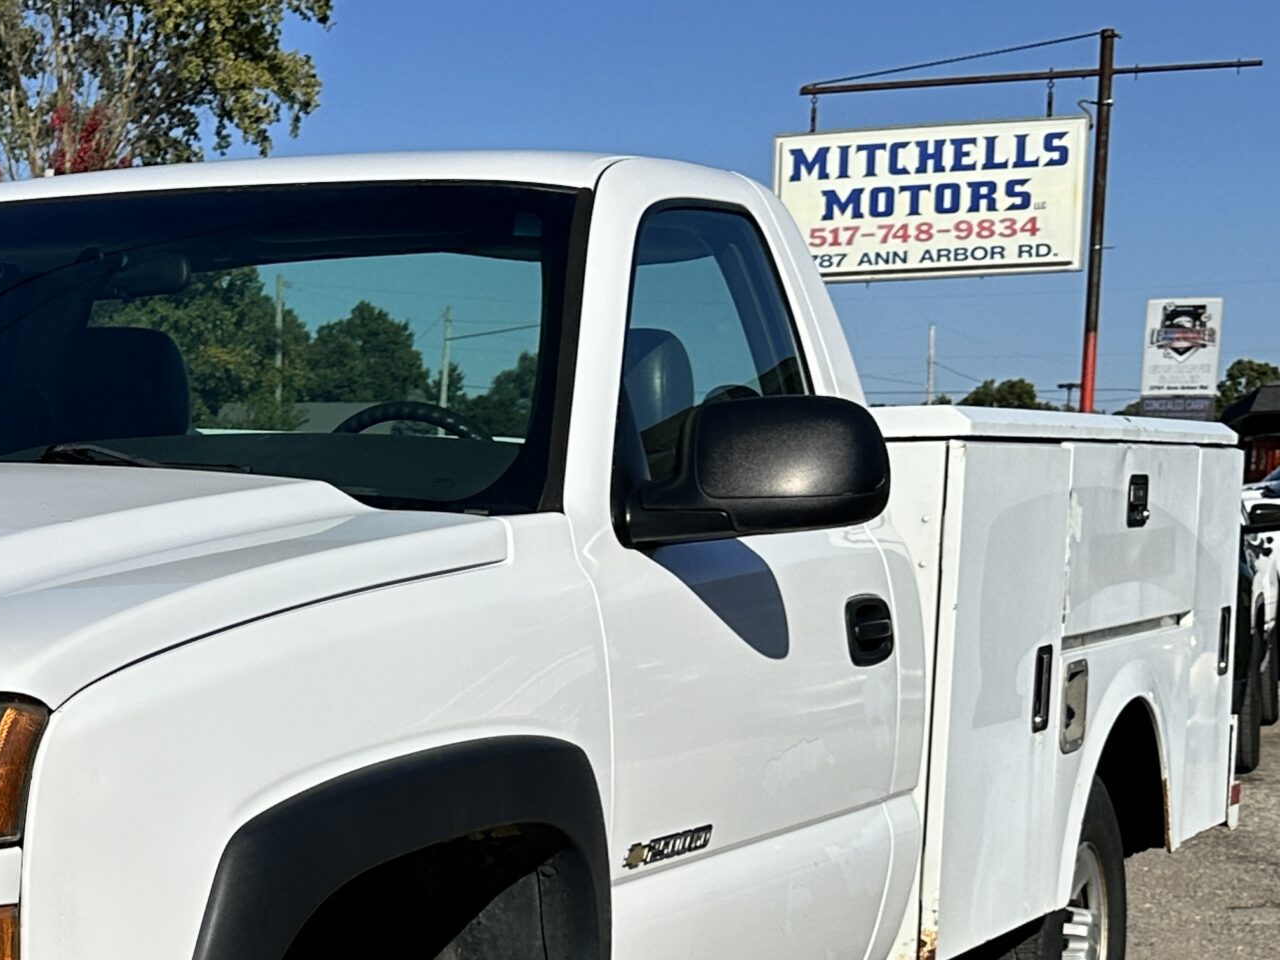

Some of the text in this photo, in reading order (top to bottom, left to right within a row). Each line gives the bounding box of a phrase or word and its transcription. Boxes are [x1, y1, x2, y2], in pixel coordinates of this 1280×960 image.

[788, 131, 1070, 182] MITCHELLS
[820, 178, 1033, 221] MOTORS
[808, 216, 1040, 248] 517-748-9834
[857, 250, 908, 266] ANN
[919, 245, 1006, 263] ARBOR
[1017, 243, 1059, 259] RD.
